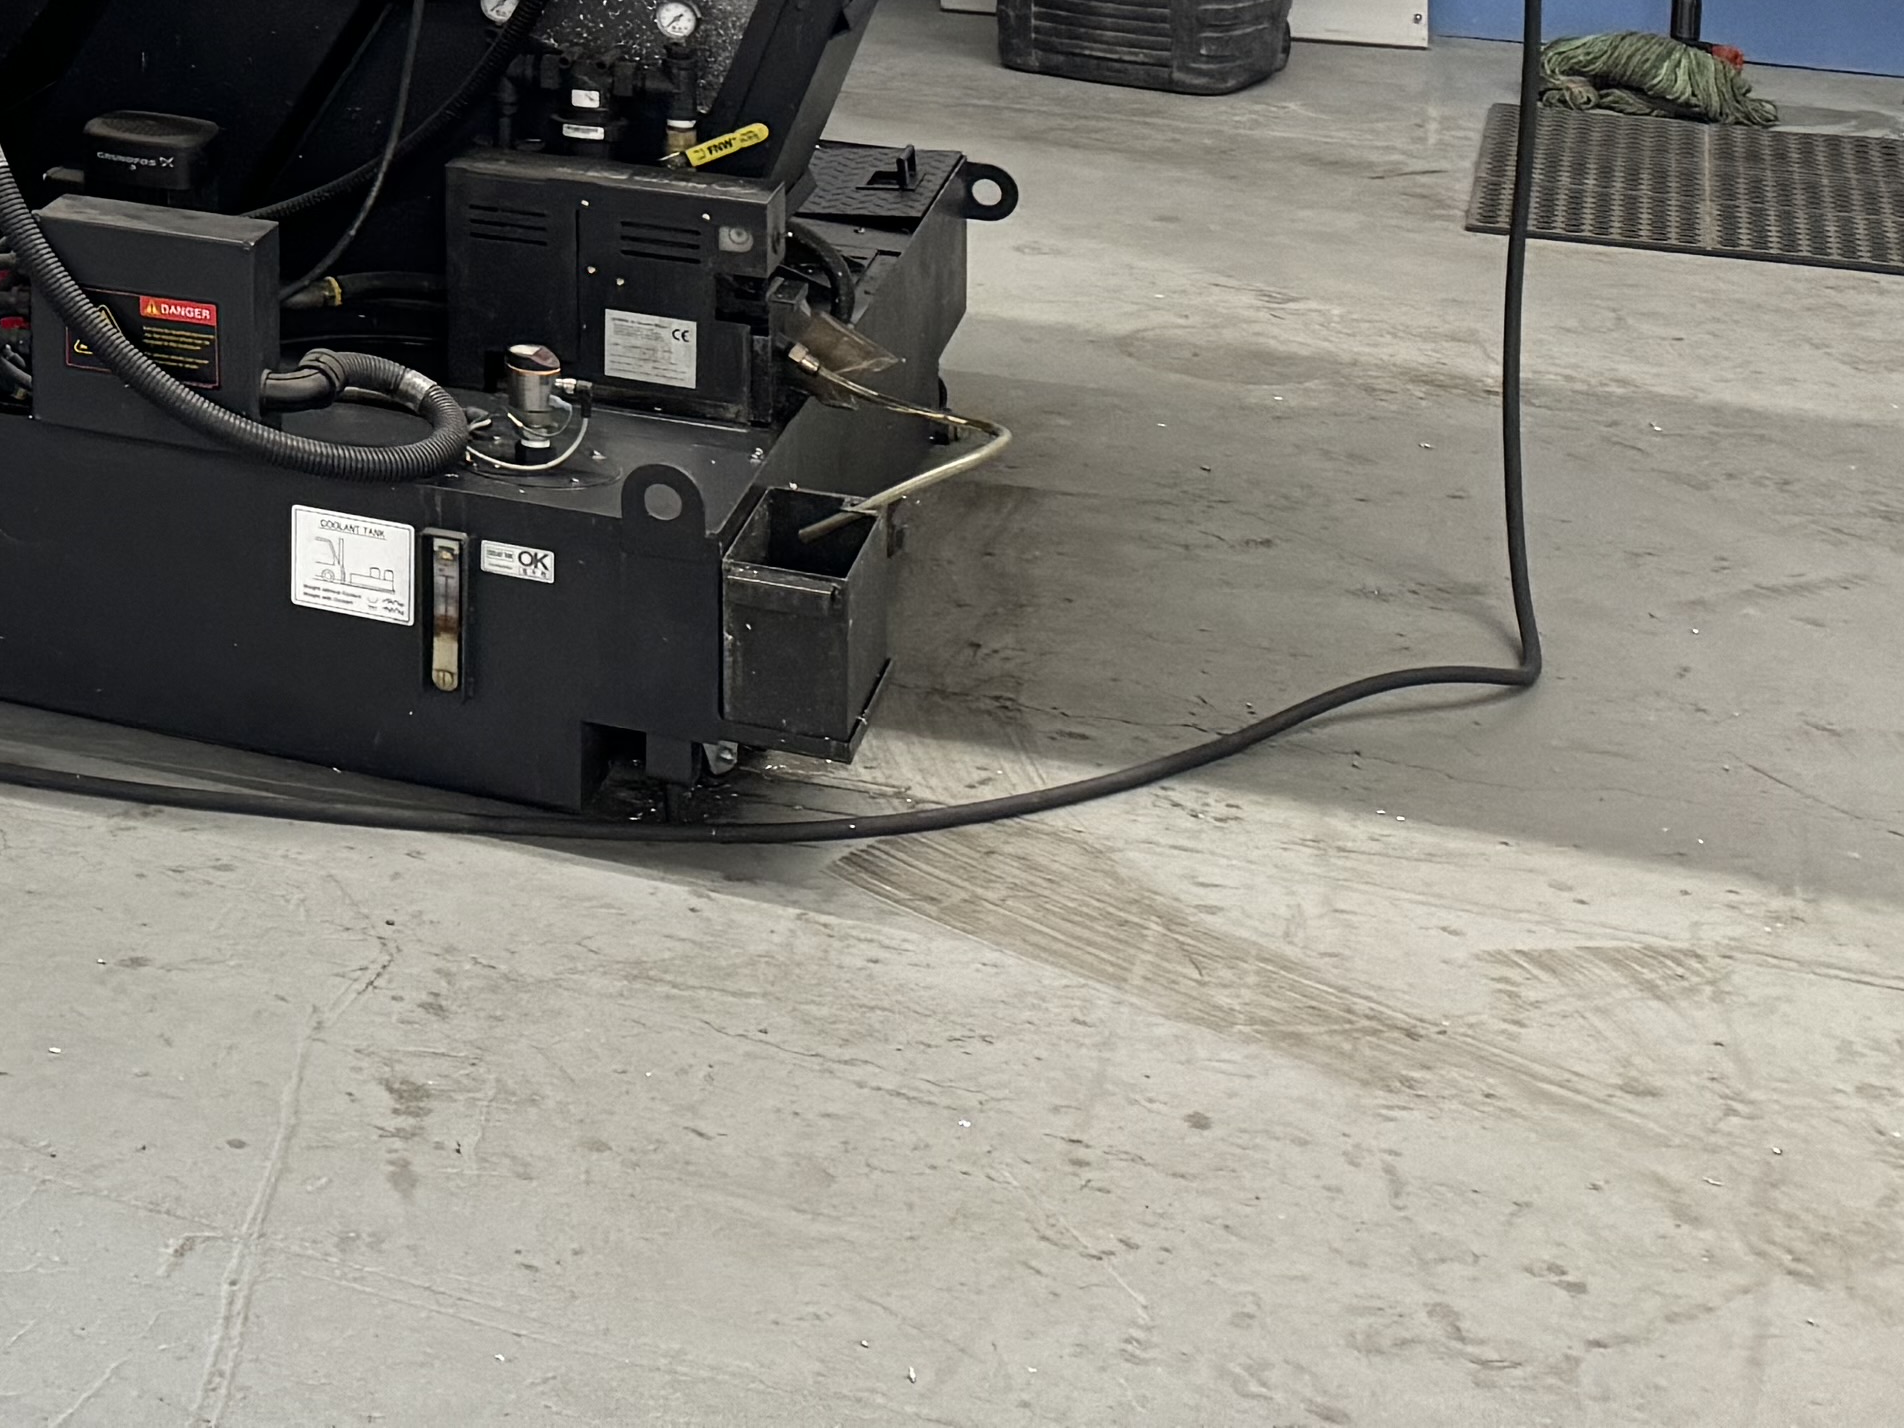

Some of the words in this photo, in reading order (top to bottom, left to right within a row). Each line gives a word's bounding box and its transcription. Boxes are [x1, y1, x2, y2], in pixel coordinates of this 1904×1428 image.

[160, 303, 211, 320] DANGER
[320, 519, 359, 535] COOLANT
[362, 526, 385, 538] TANK
[518, 550, 550, 572] OK
